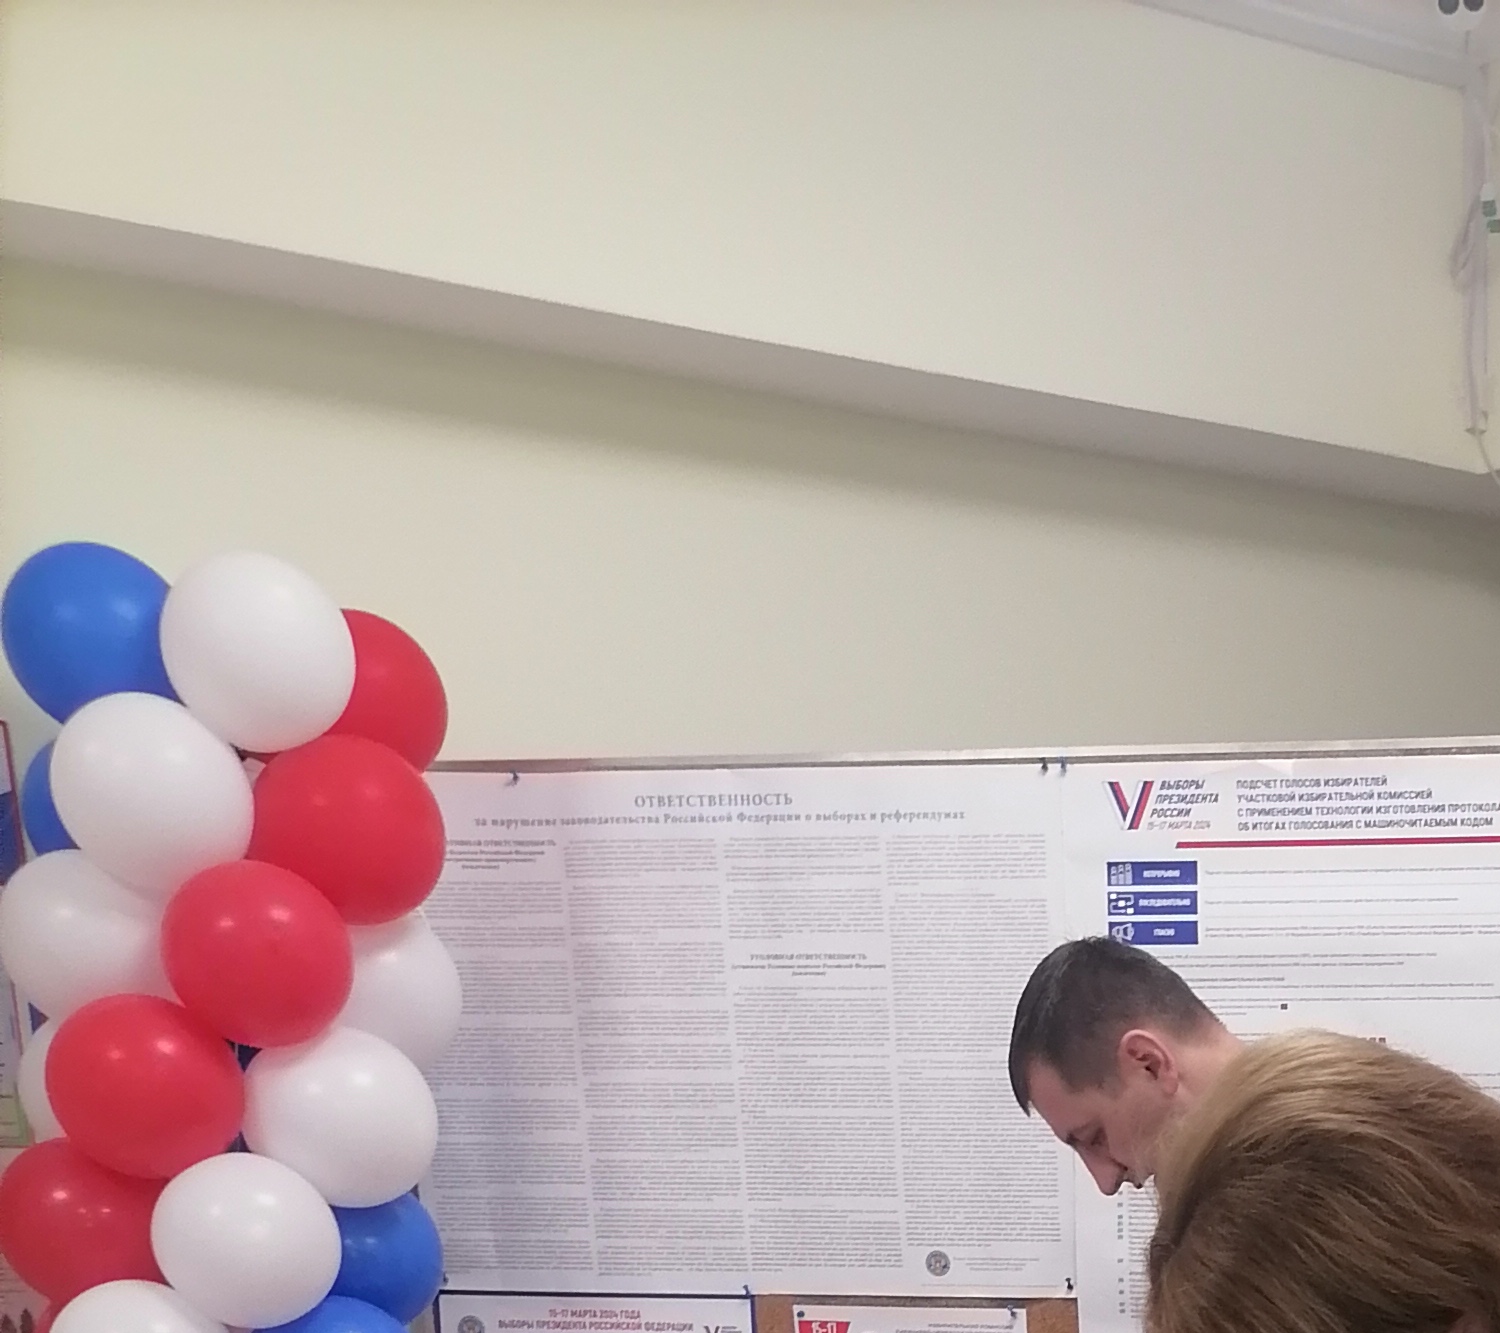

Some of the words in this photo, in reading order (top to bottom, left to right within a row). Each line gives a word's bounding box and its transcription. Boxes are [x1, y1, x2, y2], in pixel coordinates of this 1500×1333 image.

[1159, 779, 1205, 790] ВЫБОРЫ
[1236, 779, 1278, 790] ПОДСЧЕТ
[1280, 778, 1321, 789] ГОЛОСОВ
[1323, 775, 1387, 788] ИЗБИРАТЕЛЕЙ
[634, 793, 793, 808] ОТВЕТСТВЕННОСТЬ
[1154, 793, 1220, 805] ПРЕЗИДЕНТА
[1237, 791, 1296, 803] УЧАСТКОВОЙ
[1298, 789, 1375, 802] ИЗБИРАТЕЛЬНОЙ
[1377, 788, 1432, 801] КОМИССИЕЙ
[663, 812, 732, 825] Российской
[736, 811, 801, 825] Федерации
[815, 811, 867, 824] выборах
[880, 809, 966, 823] референдумах
[1150, 807, 1192, 818] РОССИИ
[1245, 806, 1313, 818] ПРИМЕНЕНИЕМ
[1315, 805, 1373, 817] ТЕХНОЛОГИИ
[1376, 804, 1446, 815] ИЗГОТОВЛЕНИЯ
[1237, 821, 1249, 831] ОБ
[1252, 820, 1286, 831] ИТОГАХ
[1288, 819, 1354, 830] ГОЛОСОВАНИЯ
[1364, 818, 1458, 829] МАШИНОЧИТАЕМЫМ
[1460, 817, 1494, 828] КОДОМ
[644, 1322, 694, 1332] ФЕДЕРАЦИИ
